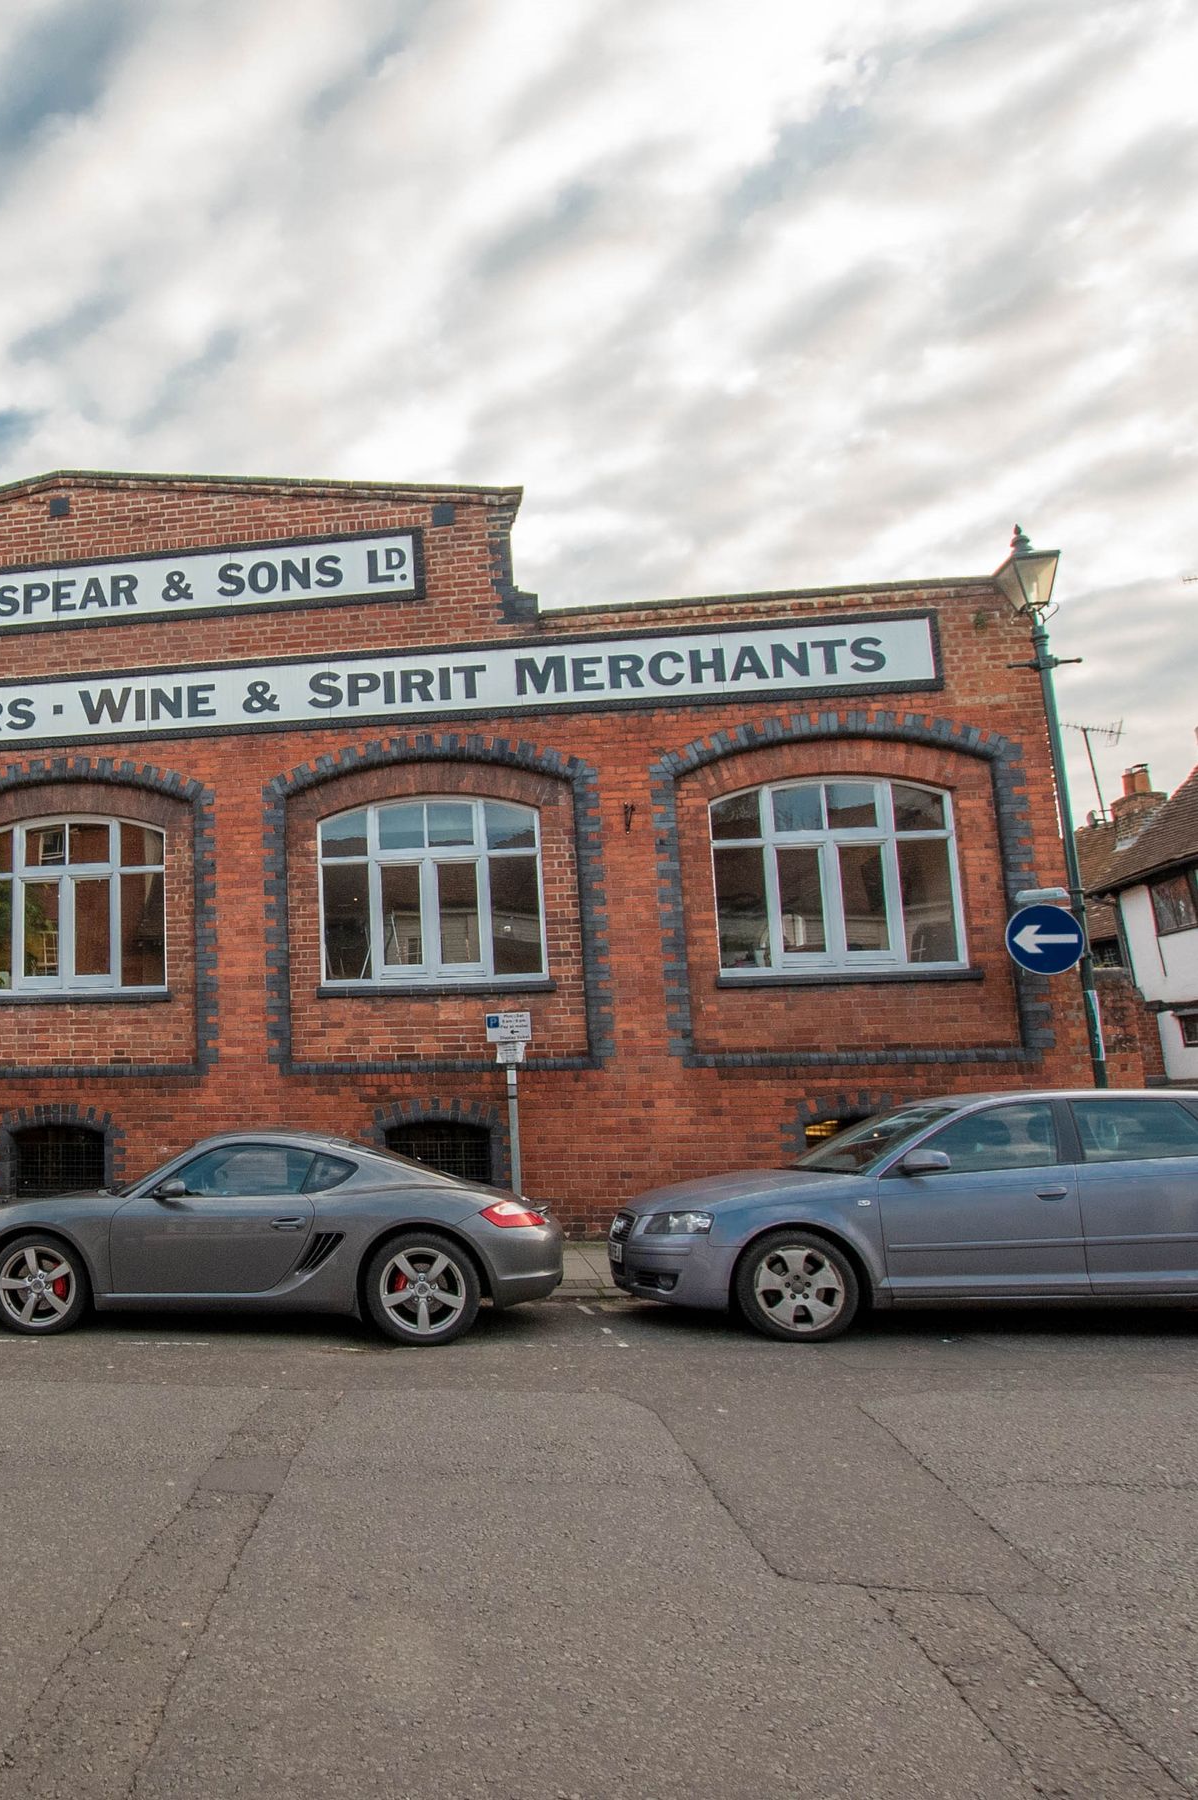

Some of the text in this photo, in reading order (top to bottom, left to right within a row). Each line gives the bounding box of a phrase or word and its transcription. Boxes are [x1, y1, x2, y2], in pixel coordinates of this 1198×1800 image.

[161, 570, 194, 602] &
[217, 555, 344, 597] SONS
[78, 683, 217, 725] WINE
[242, 680, 280, 714] &
[307, 664, 487, 709] SPIRIT
[514, 636, 886, 696] MERCHANTS
